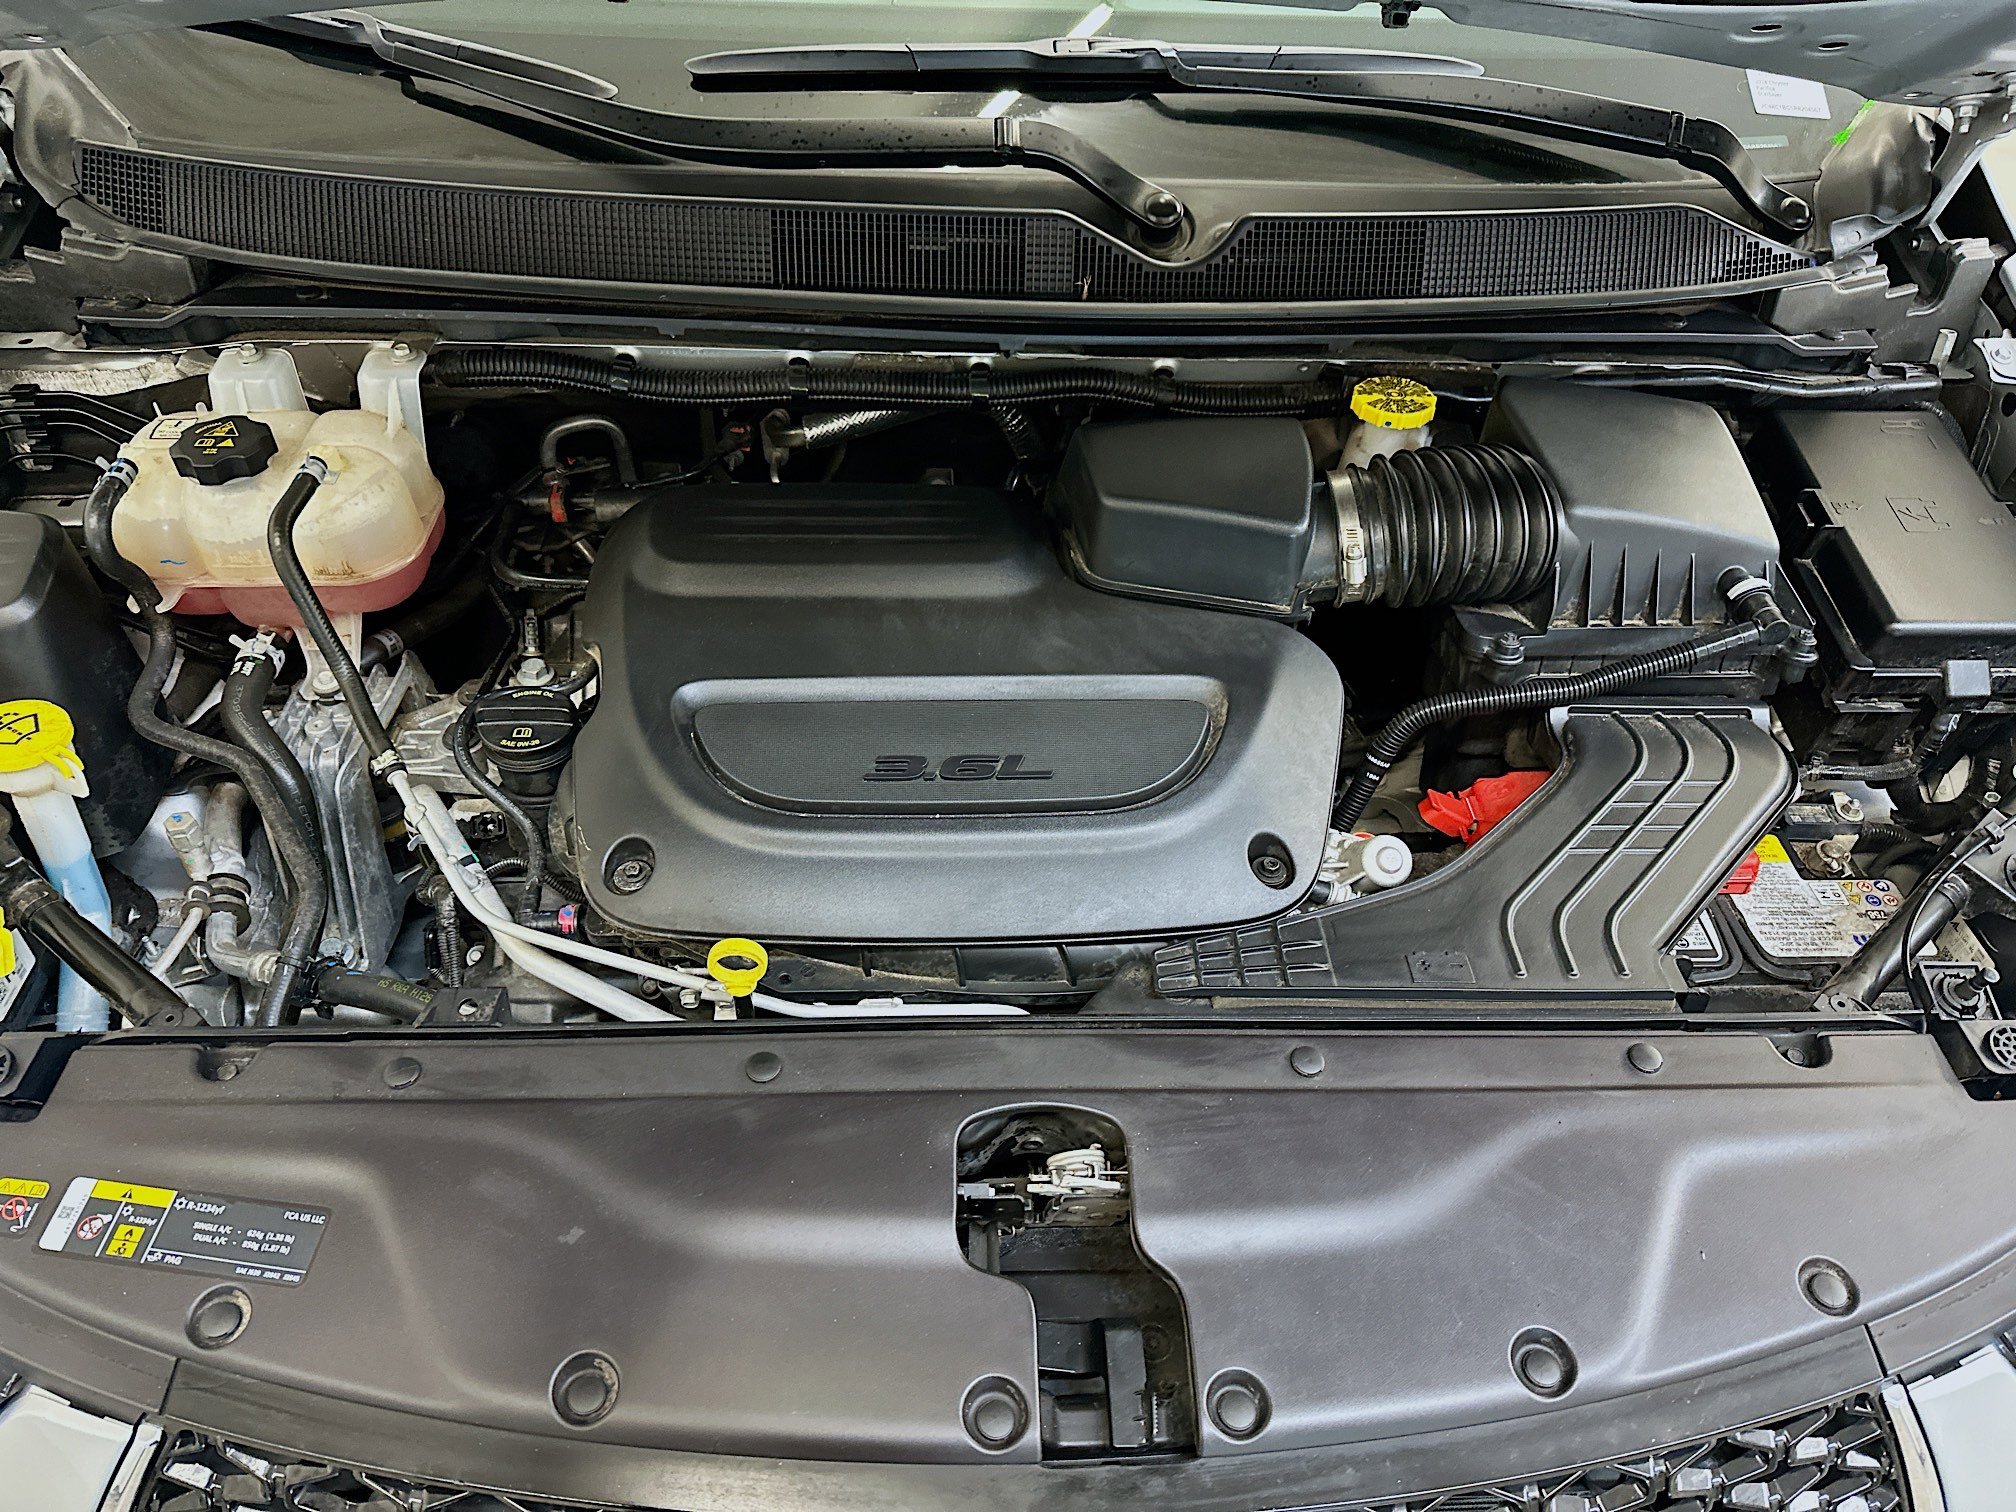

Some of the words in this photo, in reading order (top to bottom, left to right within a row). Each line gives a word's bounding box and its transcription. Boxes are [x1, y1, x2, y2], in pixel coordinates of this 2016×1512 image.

[511, 690, 542, 699] ENGINE
[500, 739, 516, 747] SAE
[862, 754, 1055, 782] 3.6L
[185, 1201, 226, 1216] R-1234yf
[283, 1211, 300, 1222] FCA
[300, 1213, 311, 1223] US
[311, 1214, 326, 1225] LLC
[192, 1221, 219, 1233] SINGLE
[218, 1224, 234, 1235] A/C
[192, 1233, 214, 1243] DUAL
[213, 1236, 229, 1246] A/C
[163, 1254, 183, 1266] PAG
